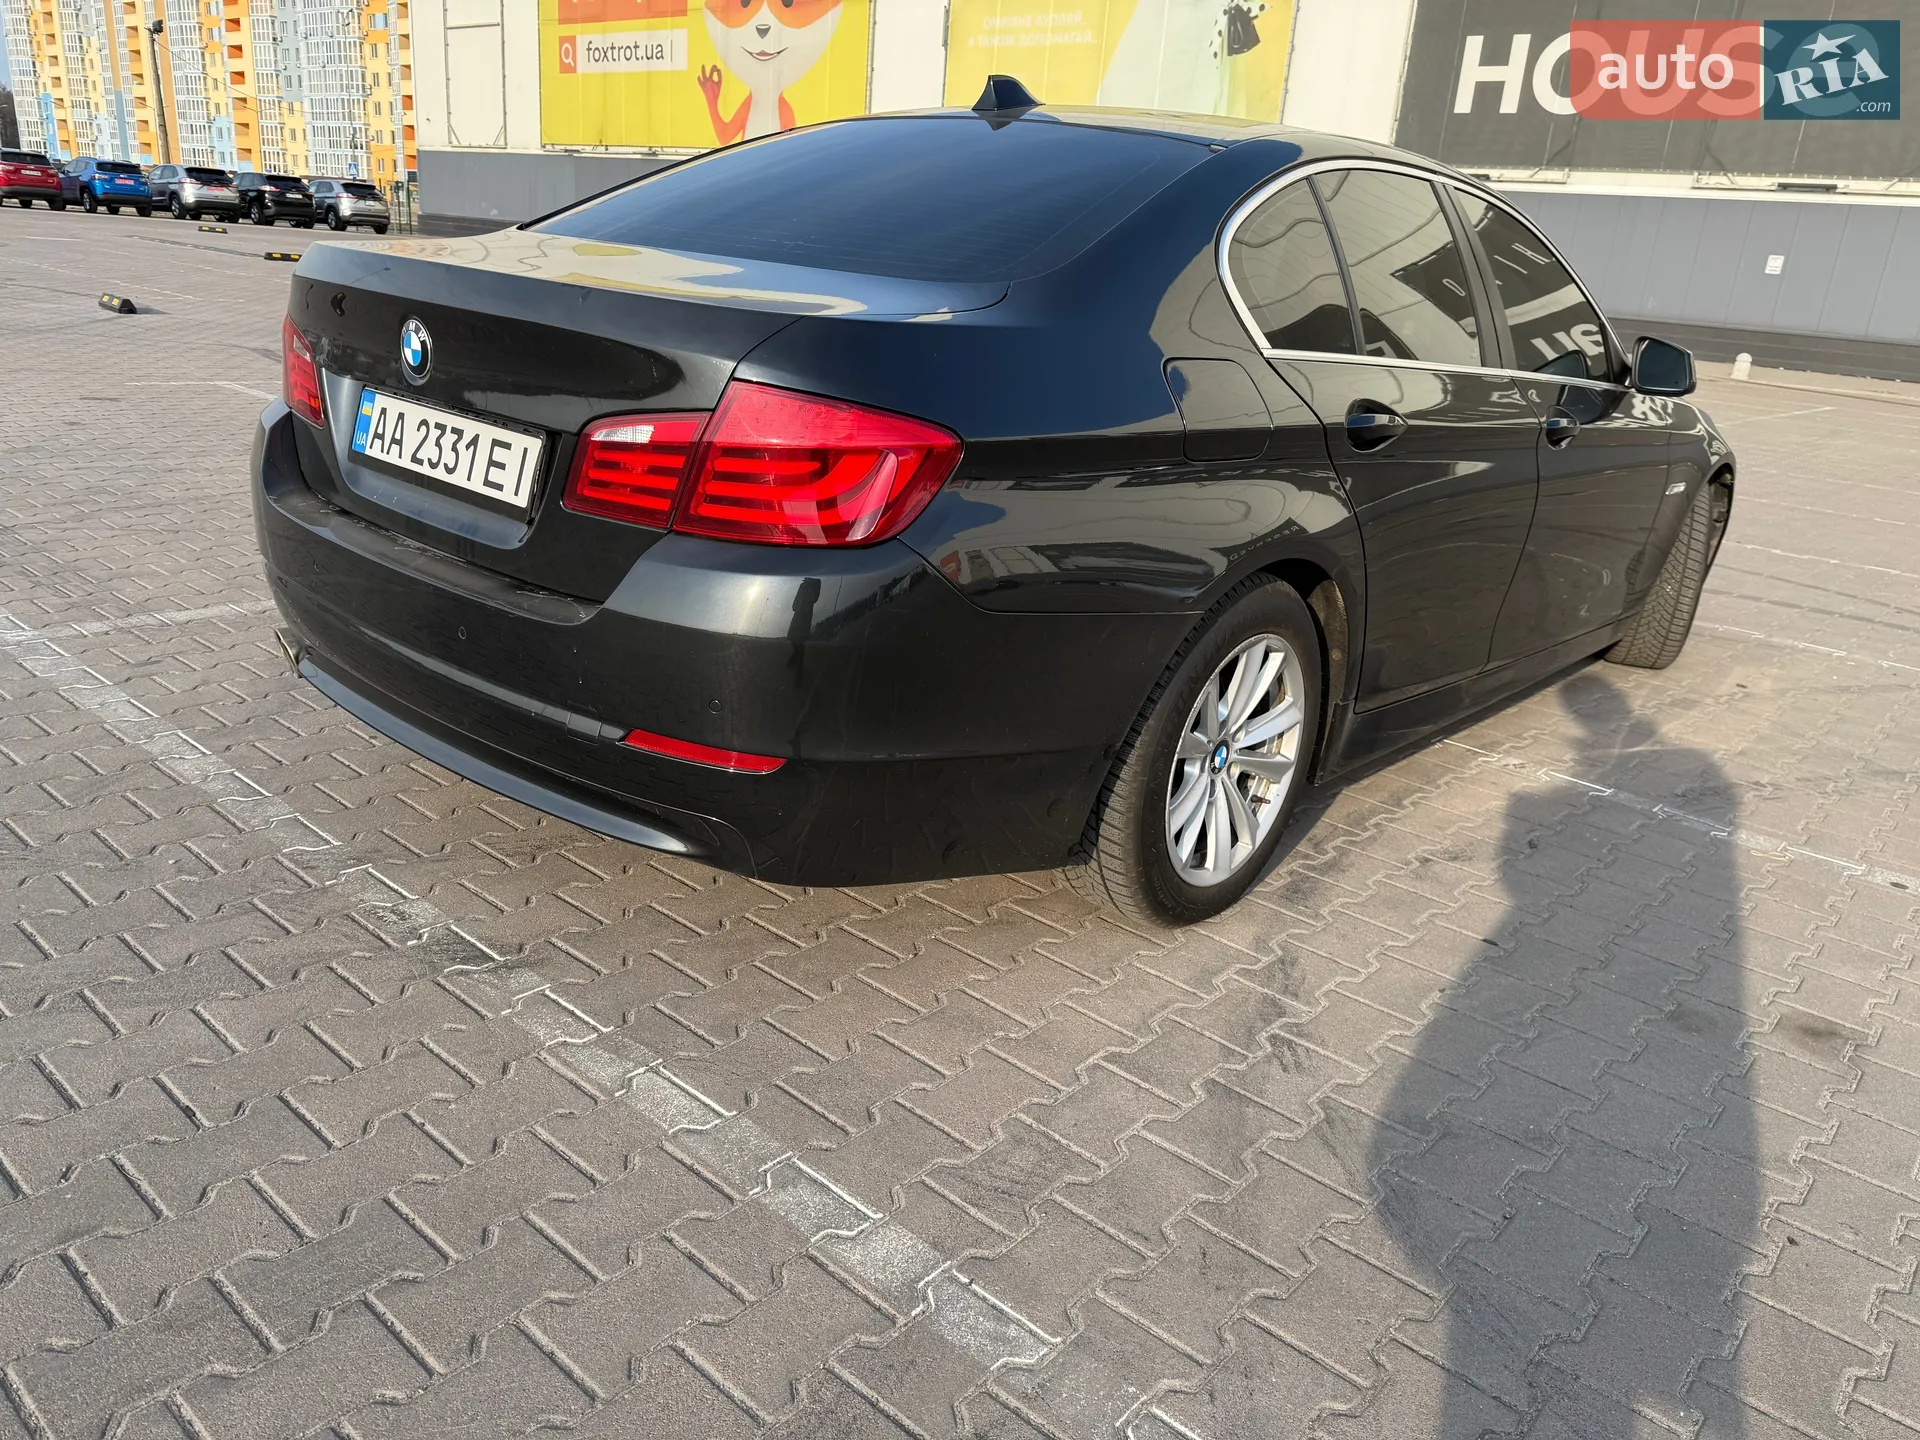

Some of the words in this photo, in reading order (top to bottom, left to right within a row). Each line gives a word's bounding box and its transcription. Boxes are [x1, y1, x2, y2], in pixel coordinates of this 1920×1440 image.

[585, 40, 665, 63] foxtrot.ua
[356, 431, 366, 446] UA
[369, 407, 405, 459] AA
[410, 418, 480, 482] 2331
[482, 437, 529, 498] EI
